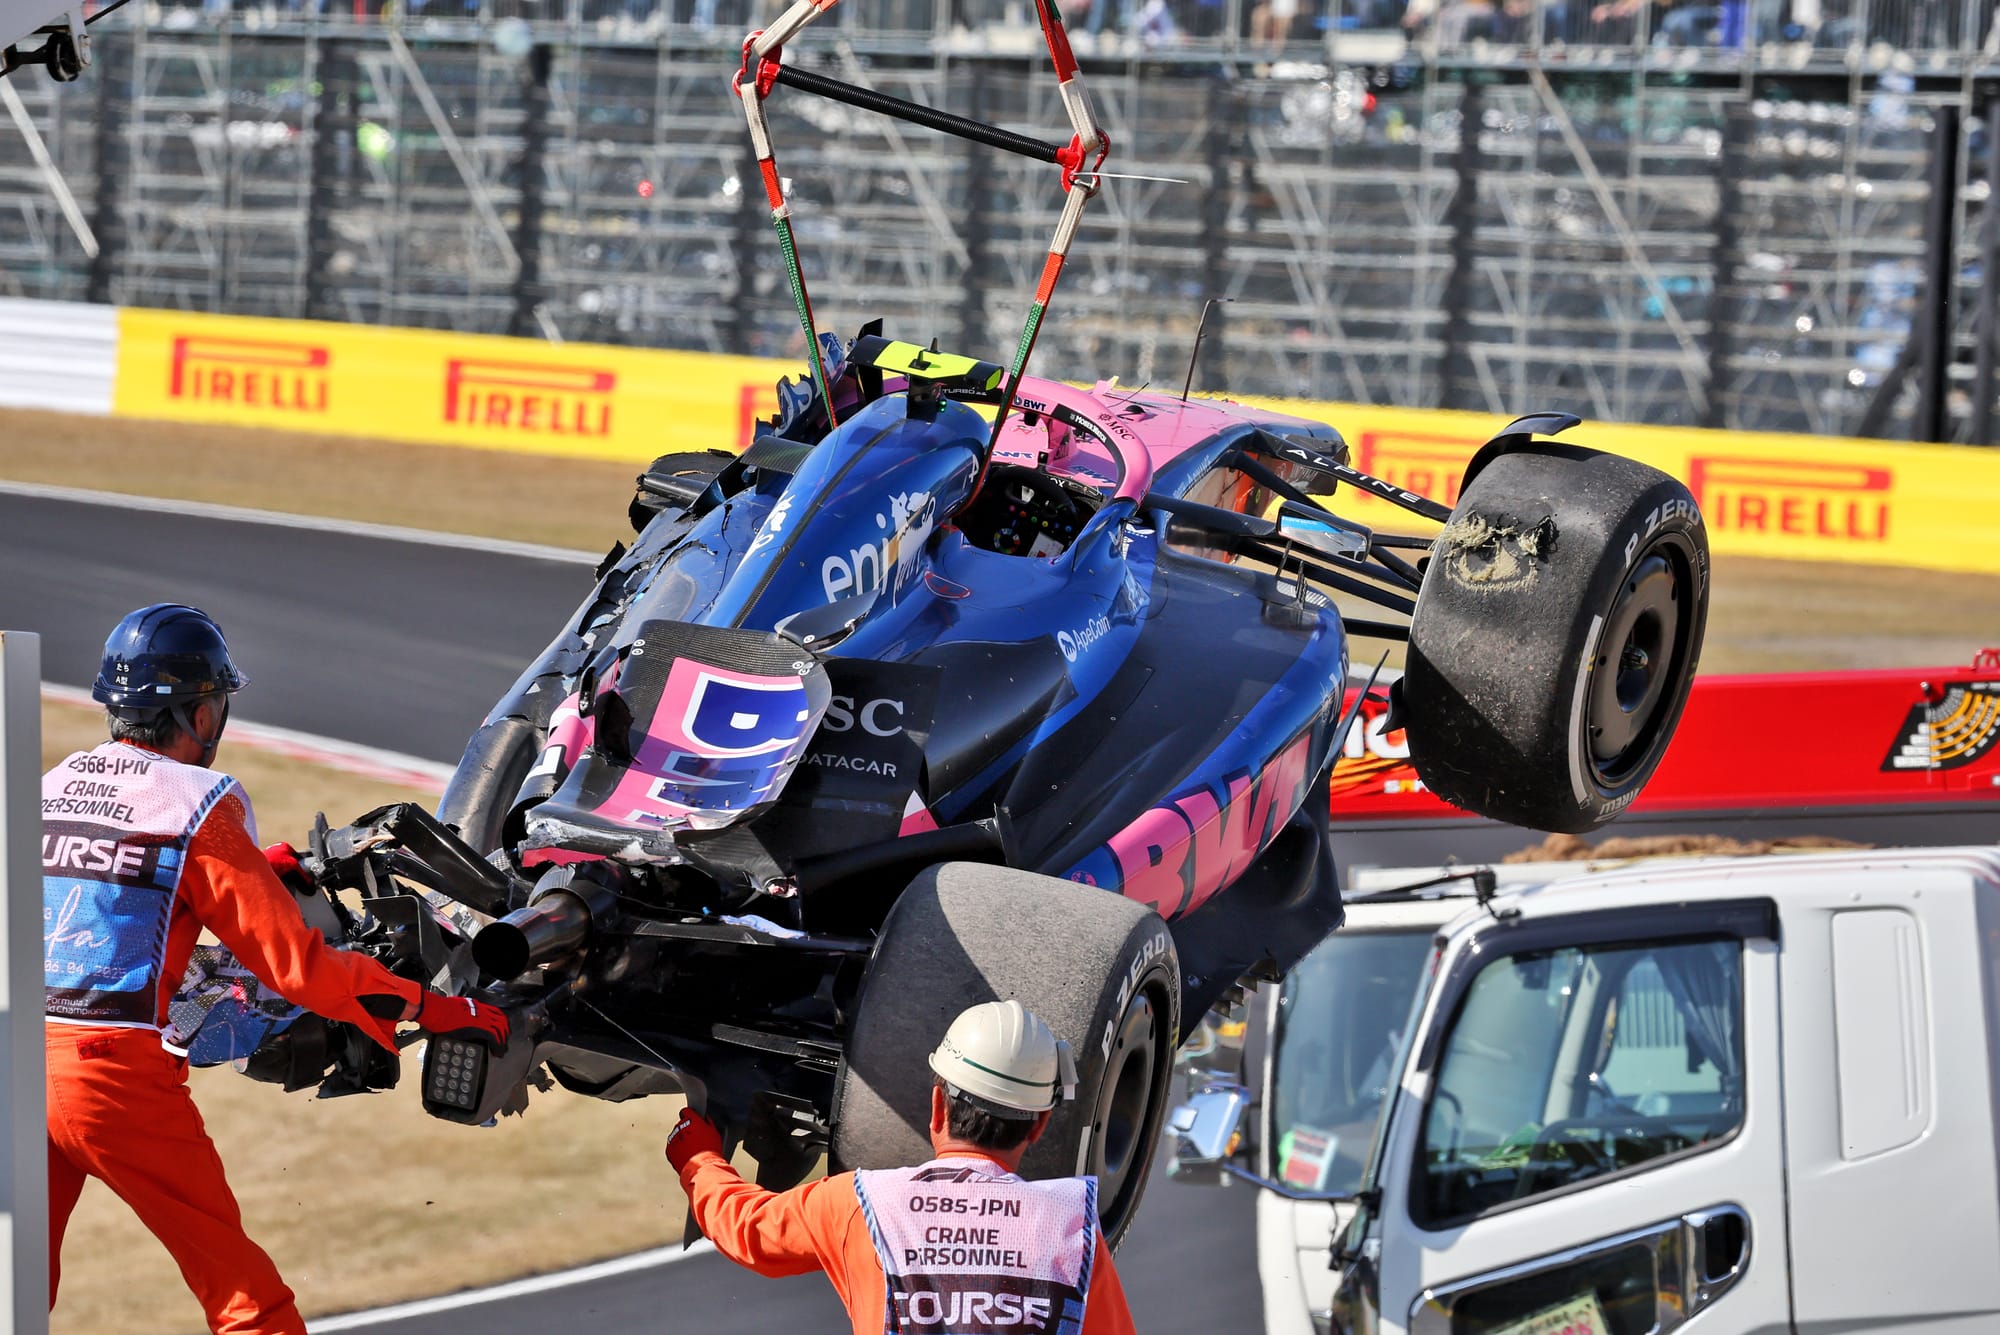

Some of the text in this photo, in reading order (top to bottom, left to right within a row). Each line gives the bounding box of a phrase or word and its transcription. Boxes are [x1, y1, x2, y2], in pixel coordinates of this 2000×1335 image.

[167, 334, 331, 413] PIRELLI
[444, 358, 617, 438] PIRELLI
[1023, 398, 1047, 412] BWT
[1107, 420, 1136, 441] MSC
[1286, 449, 1422, 503] ALPINE
[1689, 457, 1891, 541] PIRELLI
[1624, 498, 1701, 569] P ZERO
[1072, 612, 1111, 653] ApeCoin
[822, 695, 904, 737] SC
[63, 780, 121, 798] CRANE
[42, 834, 146, 877] URSE
[1101, 931, 1166, 1064] P ZERO
[909, 1195, 1022, 1218] 0585-JPN
[925, 1226, 1000, 1246] CRANE
